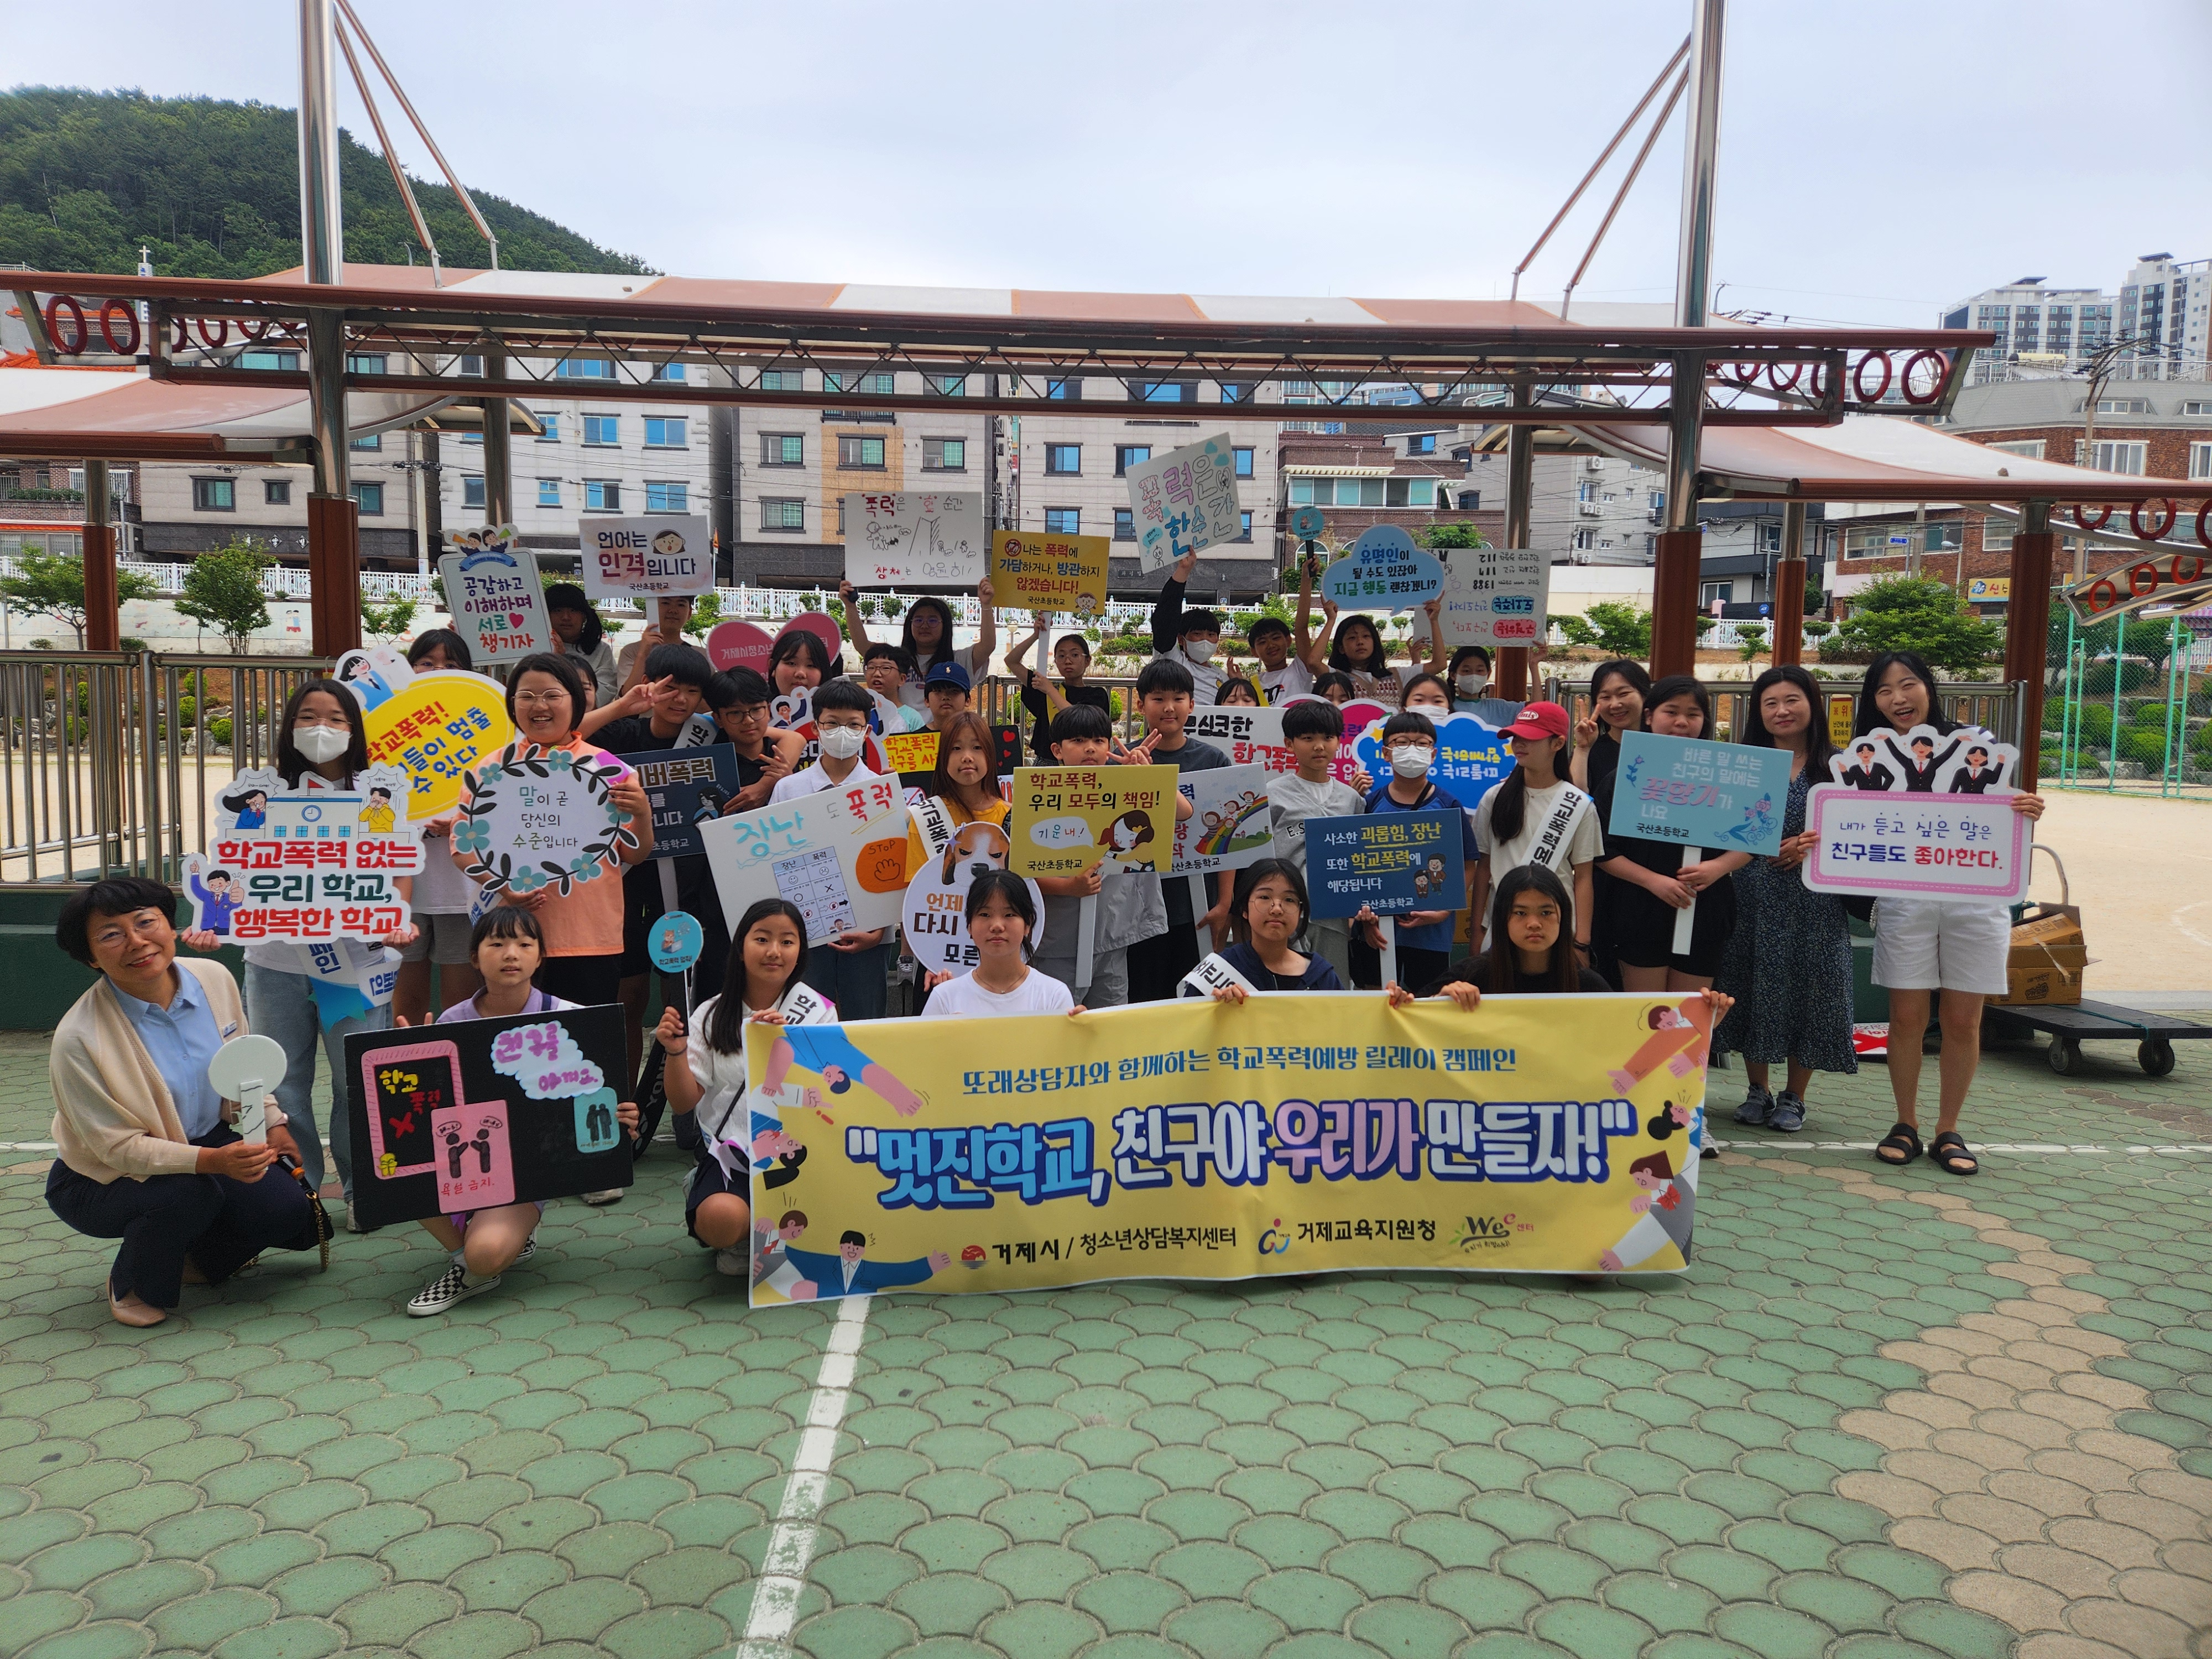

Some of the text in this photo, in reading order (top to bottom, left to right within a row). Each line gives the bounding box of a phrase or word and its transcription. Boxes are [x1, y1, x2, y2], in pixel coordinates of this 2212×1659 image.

[943, 495, 964, 510] 순간
[598, 531, 647, 549] 언어는
[1023, 543, 1078, 558] 나는 폭력에
[1360, 546, 1409, 564] 유명인이
[1479, 554, 1496, 562] 112
[598, 552, 696, 577] 인격입니다
[999, 559, 1100, 577] 가담하거나, 방관하지
[1353, 565, 1418, 580] 될 수도 있잖아
[1479, 567, 1496, 576] 117
[463, 575, 524, 597] 공감하고
[629, 582, 670, 591] 국산초등학교
[1016, 577, 1079, 594] 않겠습니다!
[1334, 580, 1437, 596] 지금 행동 괜찮겠니?
[1473, 580, 1494, 589] 1388
[465, 594, 533, 613] 이해하며
[1027, 596, 1065, 605] 국산초등학교
[1494, 598, 1534, 611] 도와주는
[478, 614, 508, 632] 서로
[1497, 622, 1535, 635] 구경하는
[479, 633, 535, 653] 챙기자
[445, 706, 492, 741] 멈출
[884, 733, 936, 755] 학교폭력
[1441, 747, 1501, 763] 함께하는
[1683, 747, 1763, 771] 바른 말 쓰는
[413, 745, 478, 794] 수 있다
[1442, 764, 1499, 780] 따돌리는
[1672, 763, 1761, 788] 친구의 말에는
[1030, 772, 1102, 790] 학교폭력,
[519, 786, 568, 806] 말이 곧
[1029, 790, 1160, 811] 우리 모두의 책임!
[1639, 776, 1734, 810] 꽃향기가
[521, 813, 560, 828] 당신의
[733, 810, 807, 857] 장난
[846, 782, 893, 822] 폭력
[1641, 805, 1668, 820] 나요
[1324, 822, 1442, 846] 사소한 괴롭힘, 장난
[1636, 823, 1689, 838] 국산초등학교
[1840, 818, 1992, 841] 내가 듣고 싶은 말은
[512, 832, 578, 850] 수준입니다
[217, 841, 418, 869] 학교폭력 없는
[781, 851, 827, 870] 장난 폭력
[1327, 850, 1421, 871] 또한 학교폭력에
[1832, 842, 2003, 870] 친구들도 좋아한다.
[1027, 859, 1082, 871] 국산초등학교
[248, 873, 392, 903] 우리 학교,
[1327, 878, 1383, 893] 해당됩니다
[233, 906, 402, 938] 행복한 학교
[914, 912, 958, 936] 다시
[963, 1046, 1516, 1095] 또래상담자와 함께하는 학교폭력예방 릴레이 캠페인
[379, 1070, 419, 1094] 학교
[1112, 1100, 1272, 1189] 친구야
[1273, 1099, 1426, 1183] 우리가
[1298, 1219, 1436, 1243] 거제교육지원청
[993, 1239, 1061, 1265] 거제시
[1080, 1227, 1237, 1256] 청소년상담복지센터
